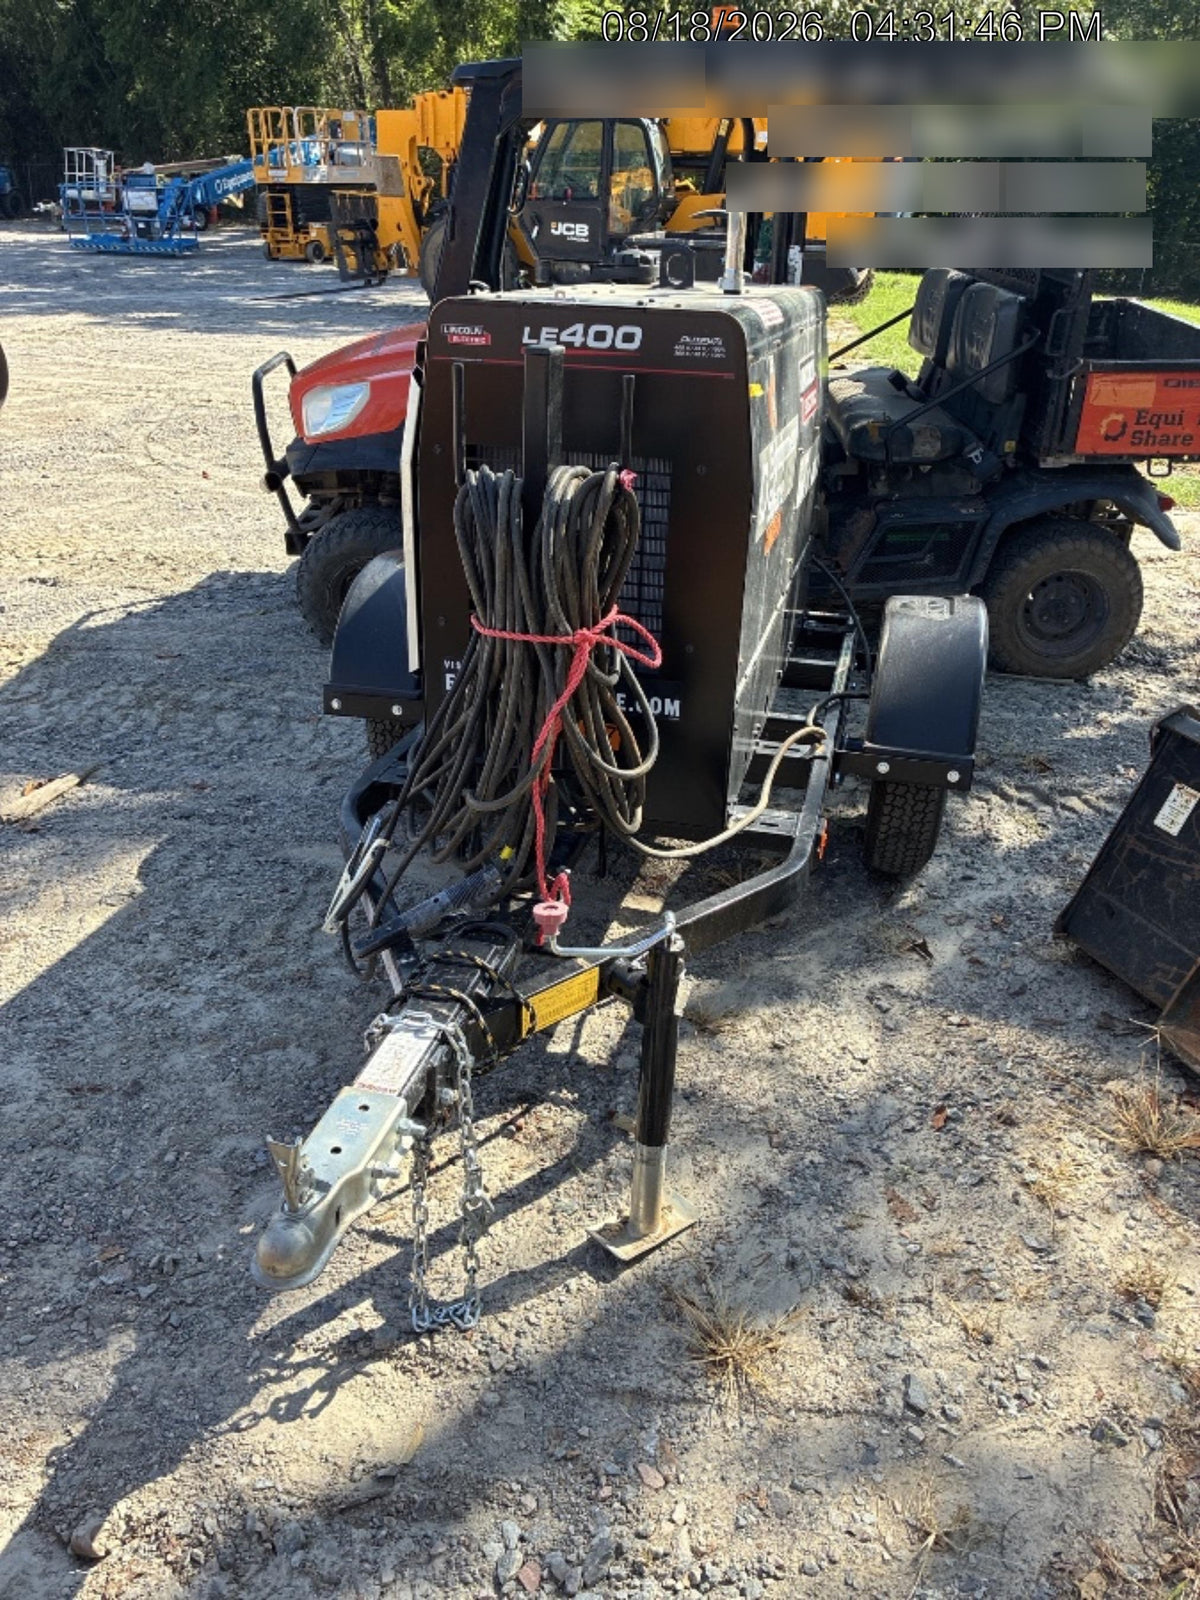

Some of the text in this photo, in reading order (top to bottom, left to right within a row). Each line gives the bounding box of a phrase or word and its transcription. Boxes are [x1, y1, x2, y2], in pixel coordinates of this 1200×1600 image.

[550, 221, 590, 237] JCB
[521, 323, 643, 350] LE400
[1134, 408, 1185, 429] Equi
[1130, 429, 1194, 448] Share
